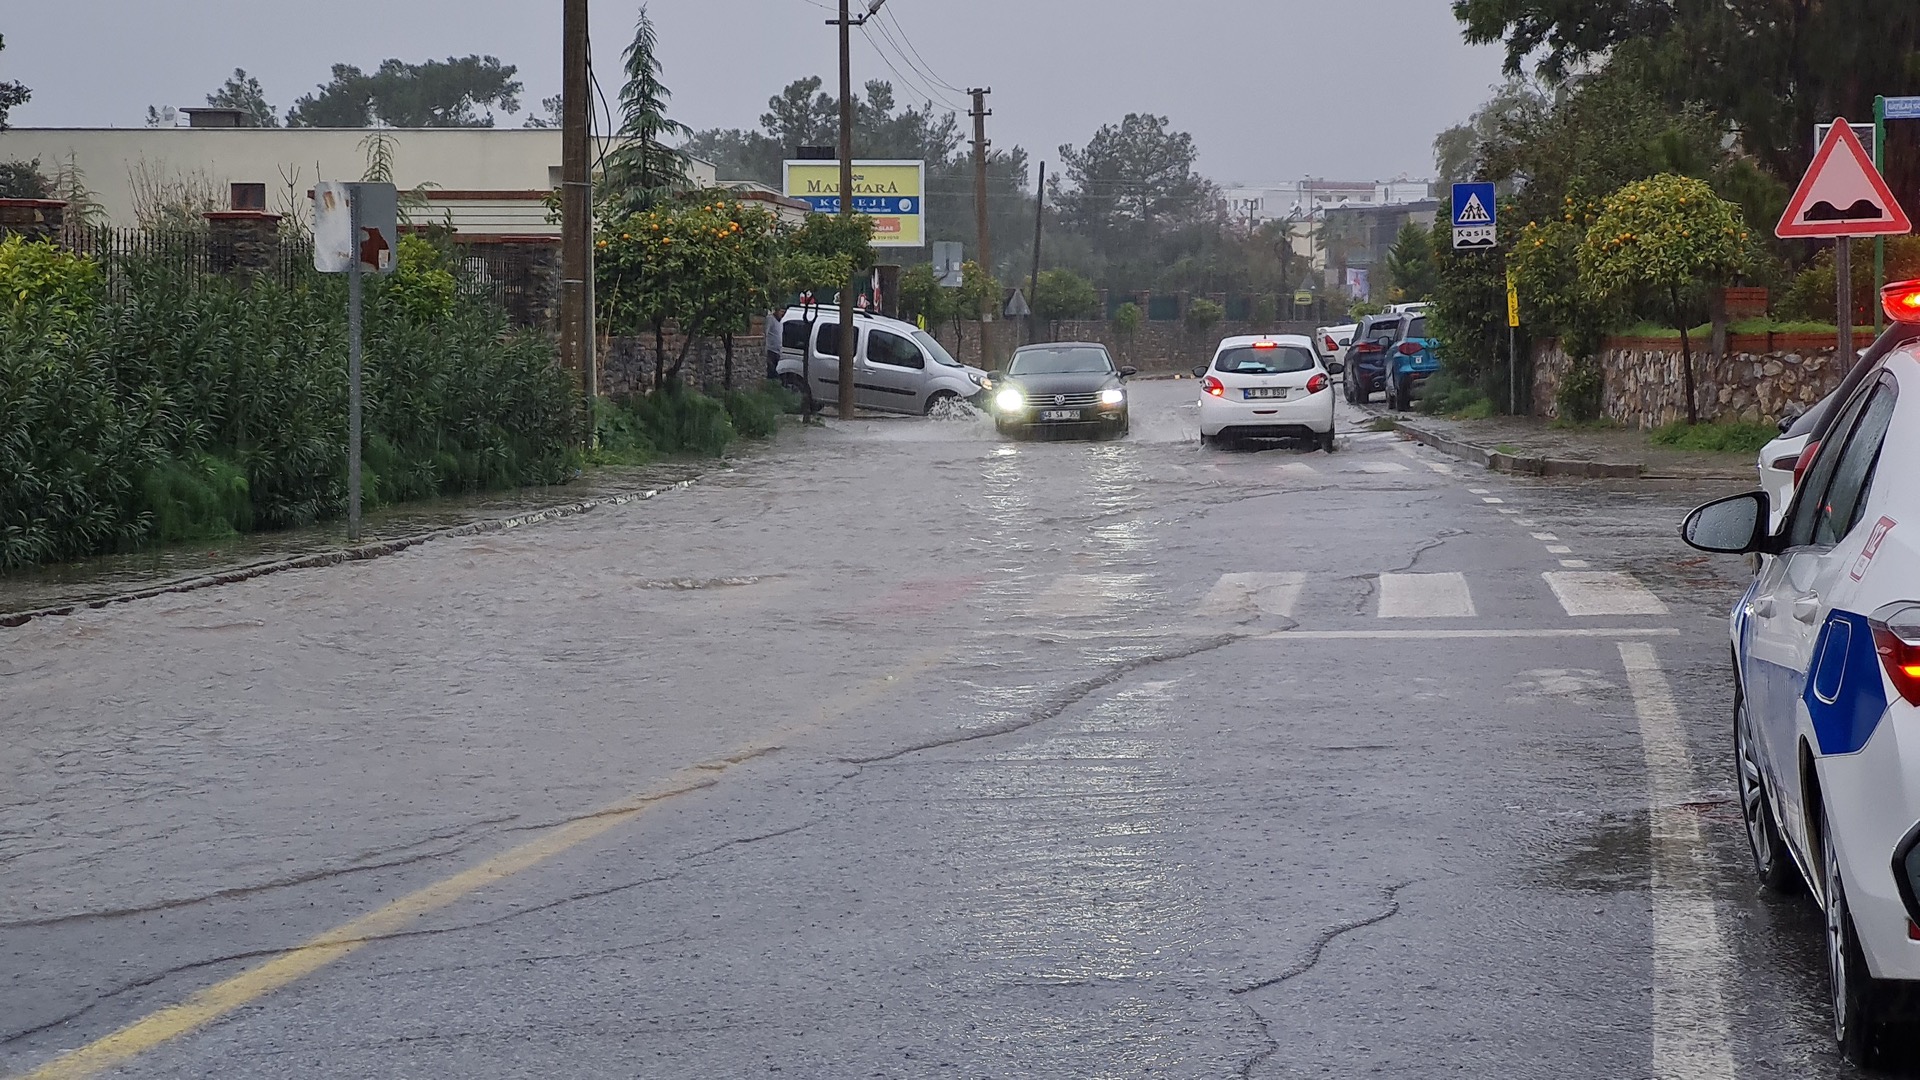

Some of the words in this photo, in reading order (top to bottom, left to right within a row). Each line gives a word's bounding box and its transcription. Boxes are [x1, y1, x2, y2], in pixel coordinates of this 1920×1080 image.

[807, 180, 898, 194] MAMARA
[819, 198, 887, 207] KOEJİ
[1457, 229, 1491, 238] Kasis
